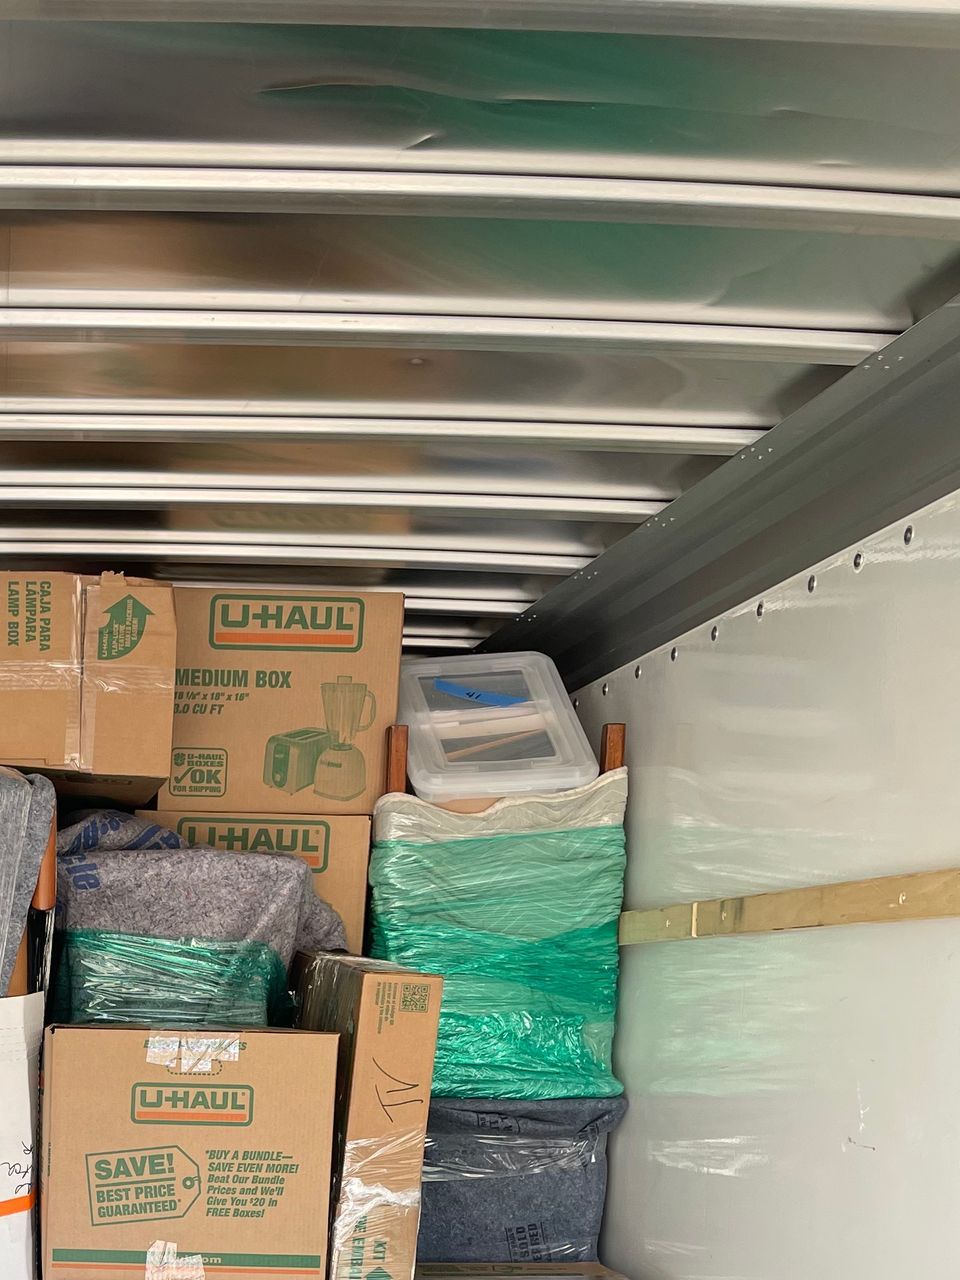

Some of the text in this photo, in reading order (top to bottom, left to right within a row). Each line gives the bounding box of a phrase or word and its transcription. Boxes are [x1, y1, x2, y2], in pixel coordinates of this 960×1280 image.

[8, 581, 19, 646] LAMP BOX
[26, 581, 39, 642] LÁMPARA
[39, 581, 51, 651] CAJA PARA
[221, 604, 354, 630] U-HAUL
[175, 669, 292, 688] MEDIUM BOX
[192, 704, 208, 714] CU
[210, 705, 224, 714] FT
[191, 769, 222, 784] OK
[140, 1090, 246, 1110] U-HAUL
[231, 1151, 239, 1160] A
[94, 1153, 175, 1180] SAVE!
[208, 1162, 299, 1174] SAVE EVEN MORE!
[207, 1174, 285, 1185] Beat Our Bundle
[96, 1184, 175, 1203] BEST PRICE
[207, 1185, 283, 1196] Prices and We'll
[207, 1197, 227, 1206] Give
[230, 1197, 247, 1207] You
[268, 1198, 278, 1207] in
[206, 1207, 265, 1218] FREE Boxes!
[373, 1240, 387, 1263] KIT
